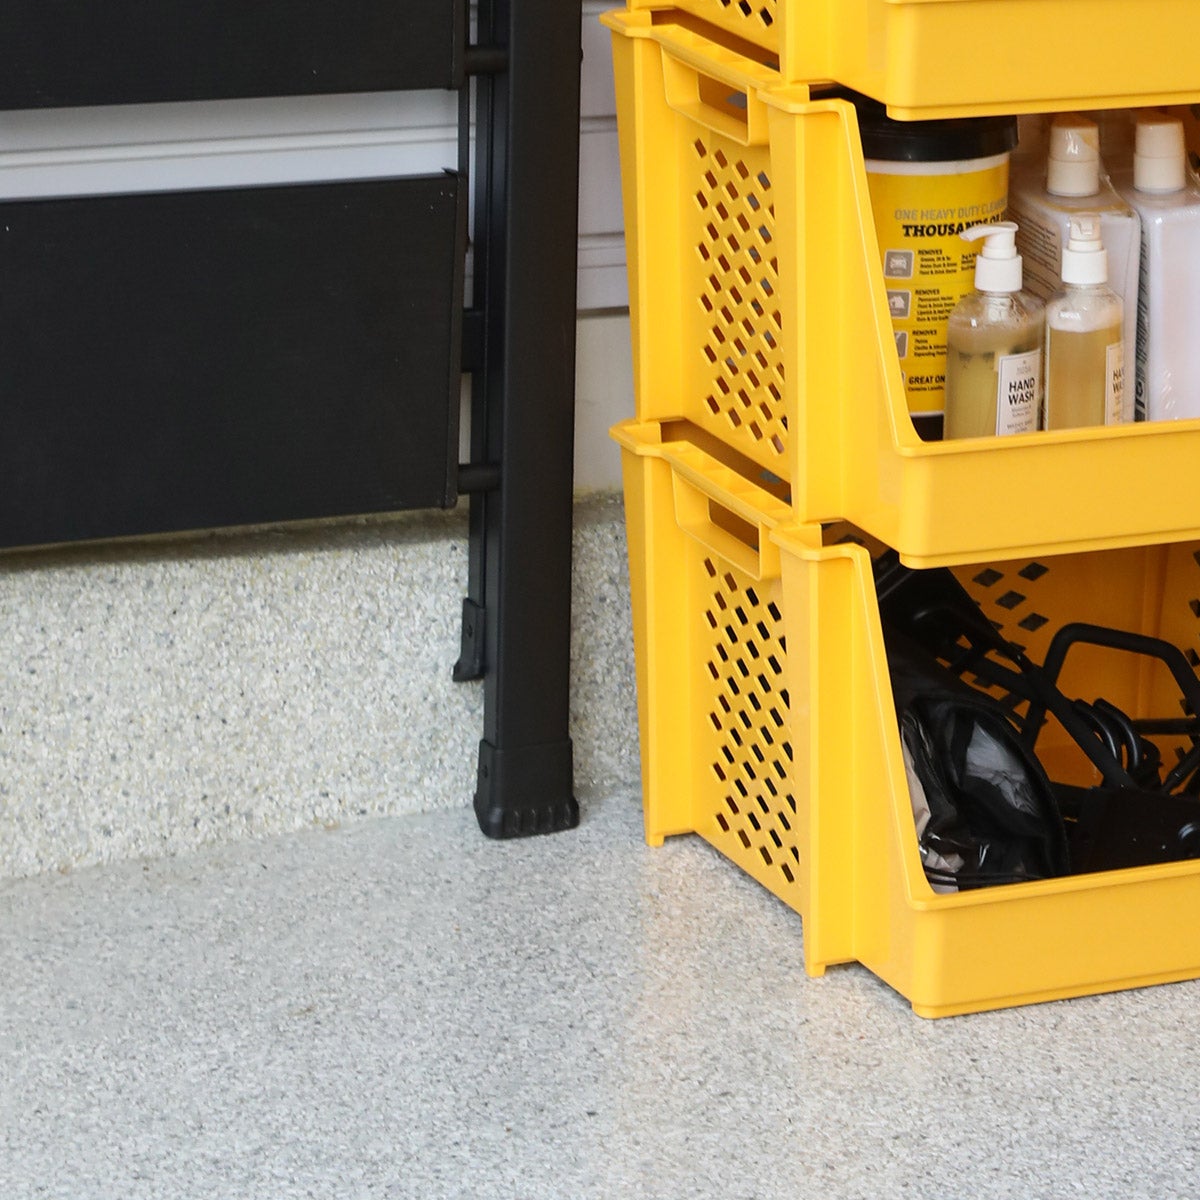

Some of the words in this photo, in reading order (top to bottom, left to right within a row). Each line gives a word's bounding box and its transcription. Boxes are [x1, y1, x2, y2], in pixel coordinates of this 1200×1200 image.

[894, 208, 918, 221] ONE
[920, 208, 955, 221] HEAVY
[958, 204, 980, 218] DUTY
[908, 376, 933, 384] GREAT
[1009, 377, 1035, 393] HAND
[1008, 390, 1035, 406] WASH
